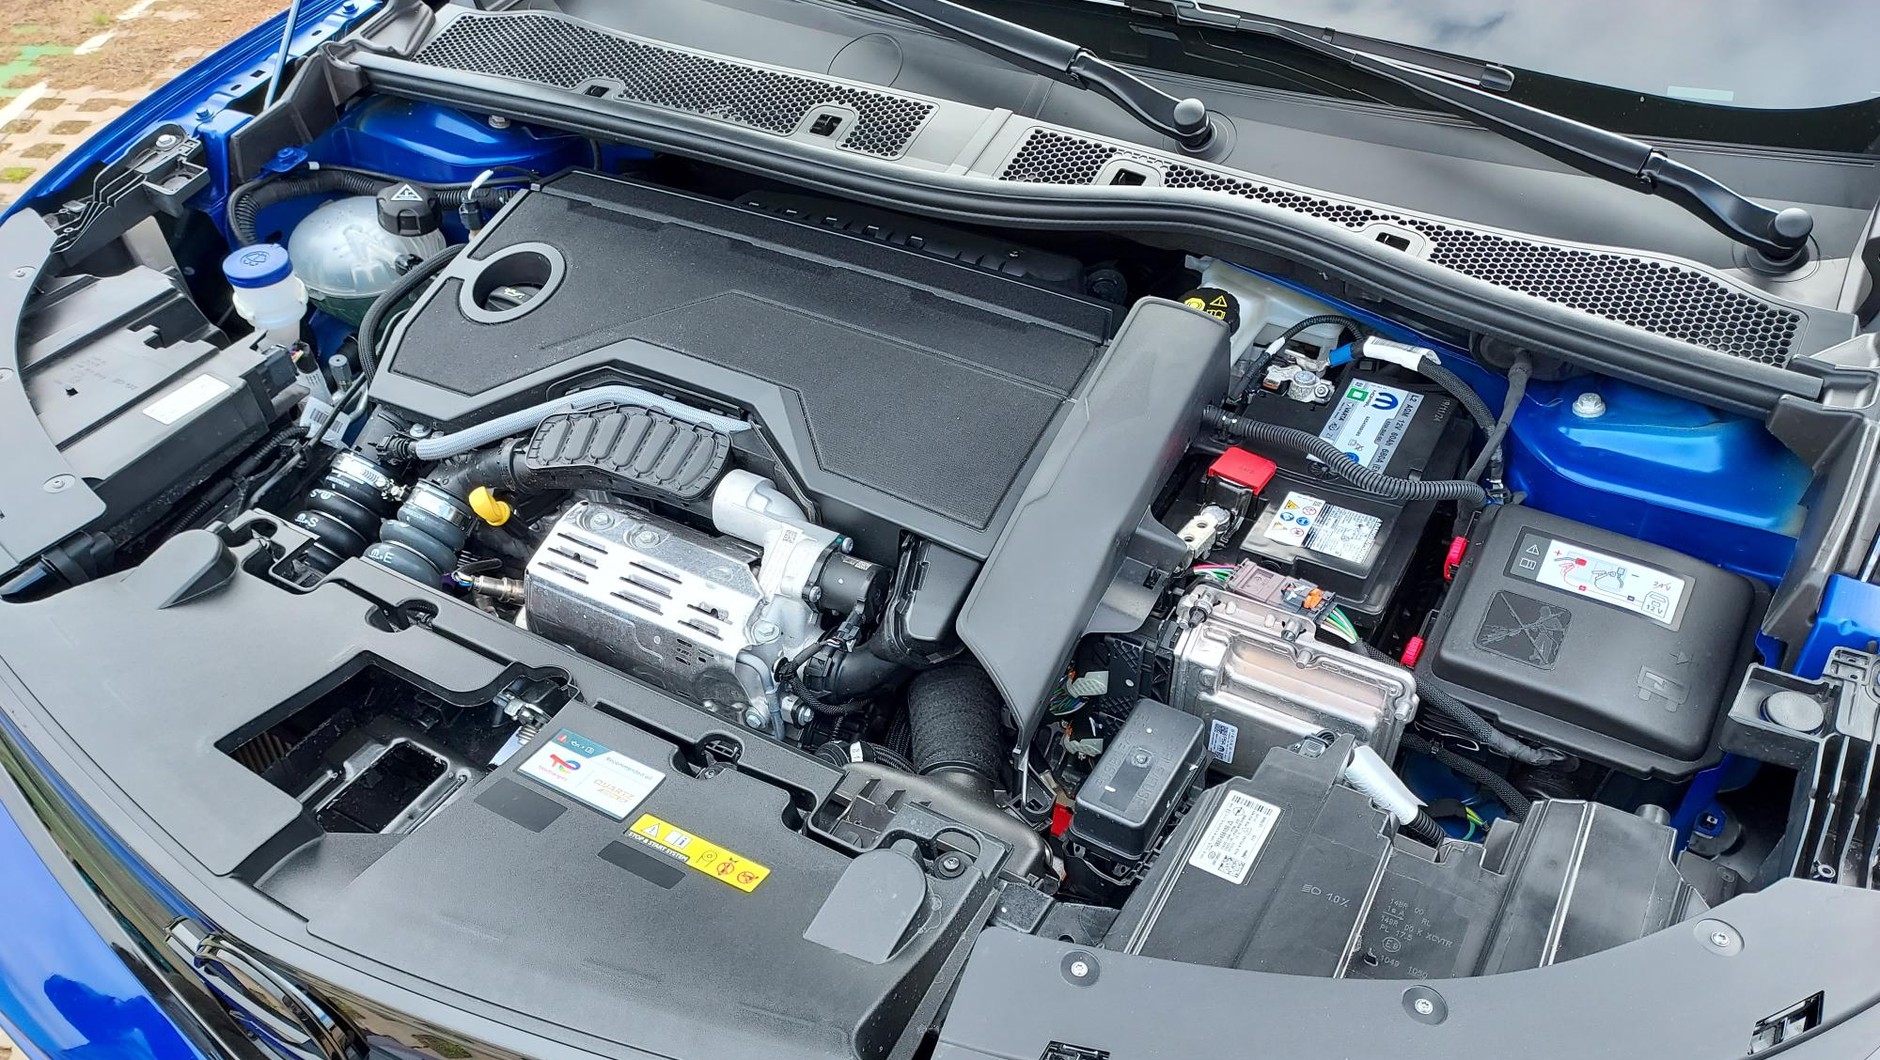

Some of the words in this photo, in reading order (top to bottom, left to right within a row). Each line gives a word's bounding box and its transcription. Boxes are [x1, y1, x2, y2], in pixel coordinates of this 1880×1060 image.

[1408, 394, 1418, 402] L2
[1338, 405, 1352, 421] VARTA
[1400, 403, 1413, 417] AGM
[1393, 419, 1405, 430] 12V
[1384, 431, 1399, 446] 60Ah
[1375, 448, 1389, 463] 680A
[628, 831, 644, 841] STOP
[648, 840, 666, 852] START
[665, 848, 688, 862] SYSTEM
